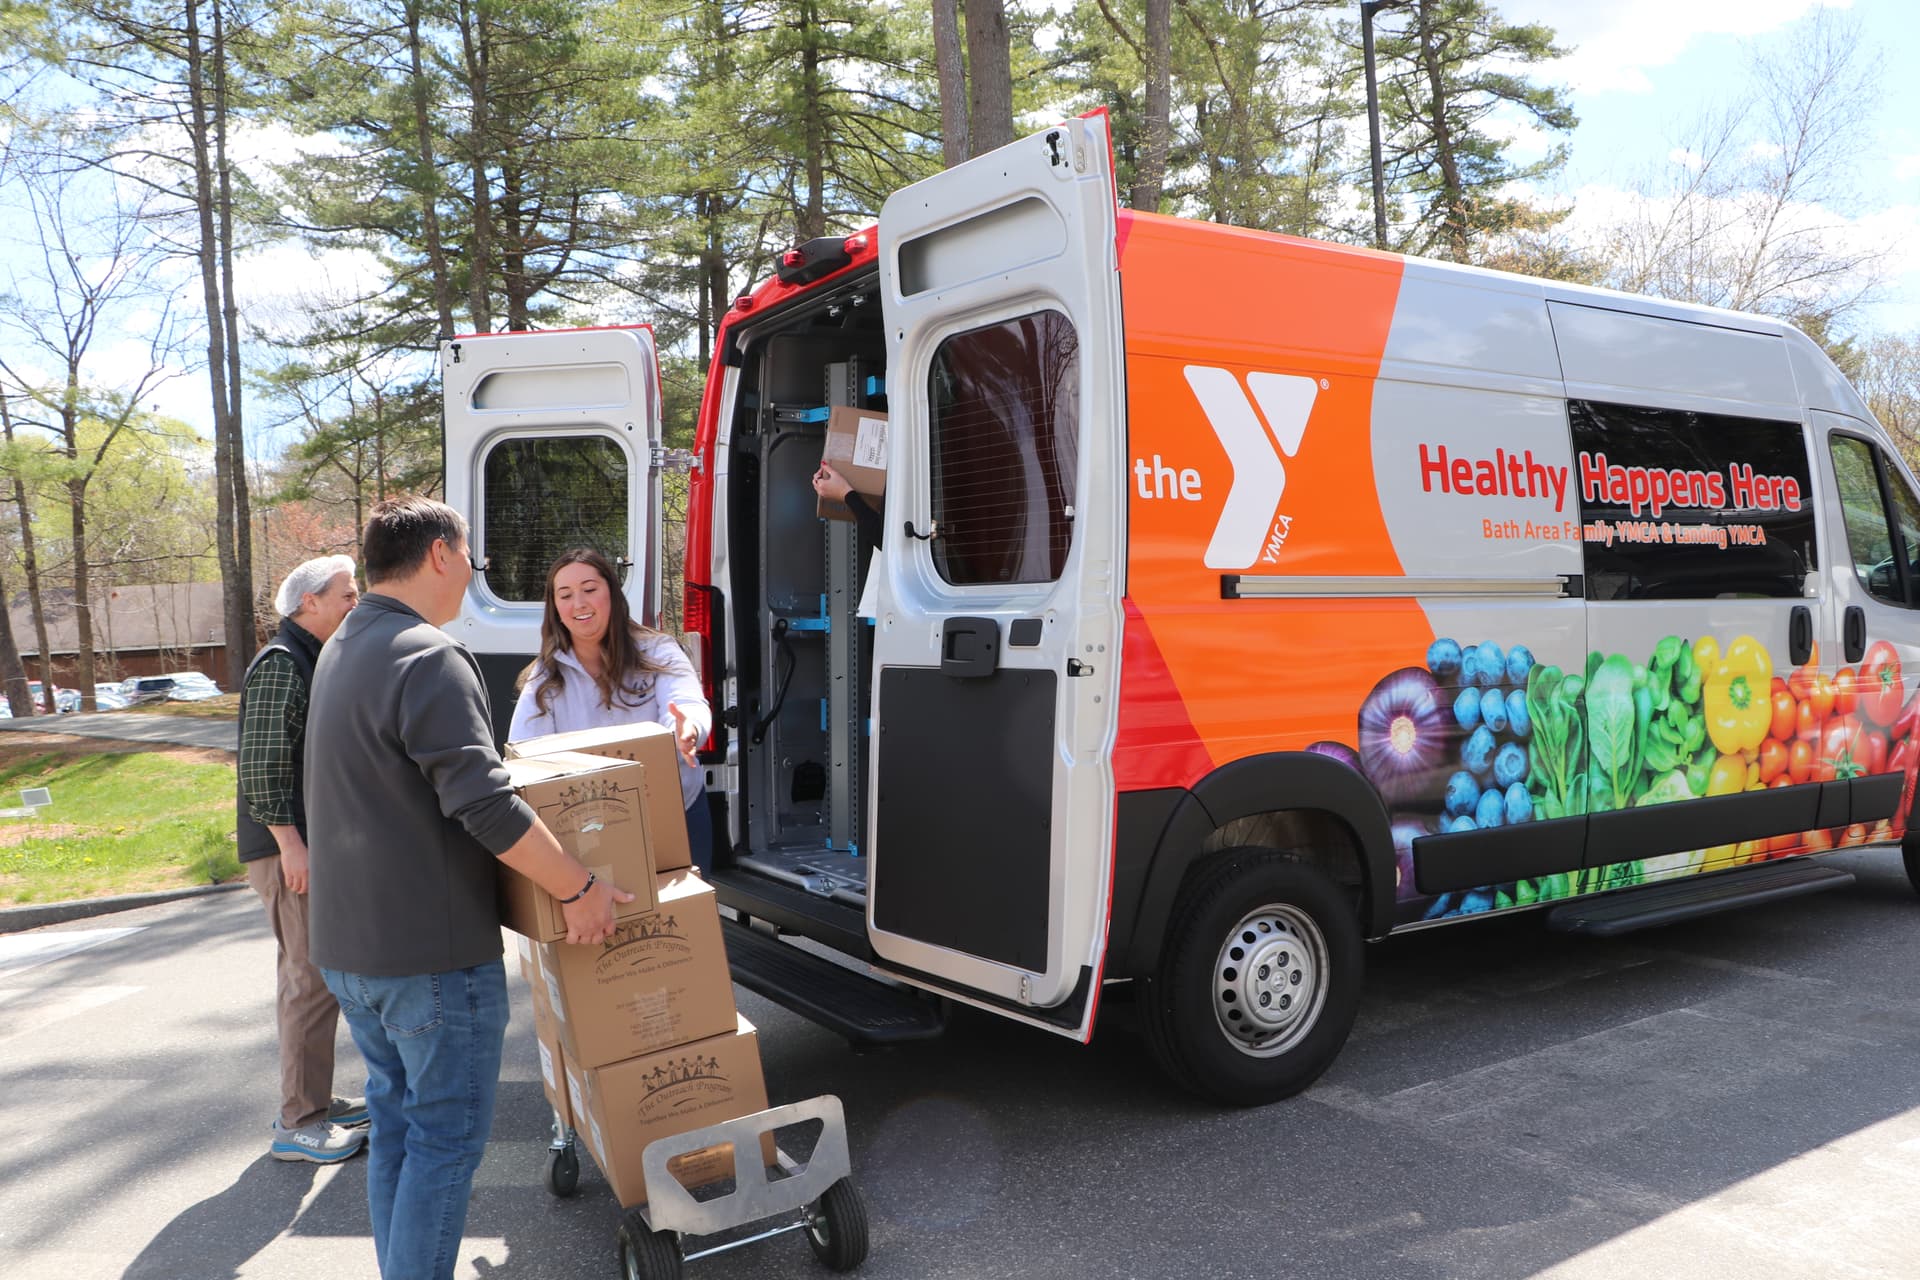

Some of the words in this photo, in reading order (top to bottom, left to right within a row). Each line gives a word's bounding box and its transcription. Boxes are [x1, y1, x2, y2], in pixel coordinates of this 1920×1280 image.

[1134, 454, 1202, 501] the
[1183, 364, 1318, 569] Y
[1419, 443, 1568, 513] Healthy
[1579, 451, 1726, 518] Happens
[1729, 462, 1802, 512] Here
[1262, 514, 1293, 564] YMCA
[1482, 518, 1521, 539] Bath
[1524, 519, 1560, 540] Area
[1563, 520, 1615, 548] Family
[1615, 520, 1660, 543] YMCA
[1661, 521, 1673, 544] &
[1675, 522, 1728, 550] Landing
[1728, 524, 1767, 546] YMCA
[595, 958, 613, 976] The
[614, 941, 652, 962] Outreach
[655, 940, 691, 955] Program
[638, 1102, 655, 1118] The
[656, 1083, 693, 1104] Outreach
[696, 1081, 732, 1094] Program
[293, 1132, 320, 1148] HOKA
